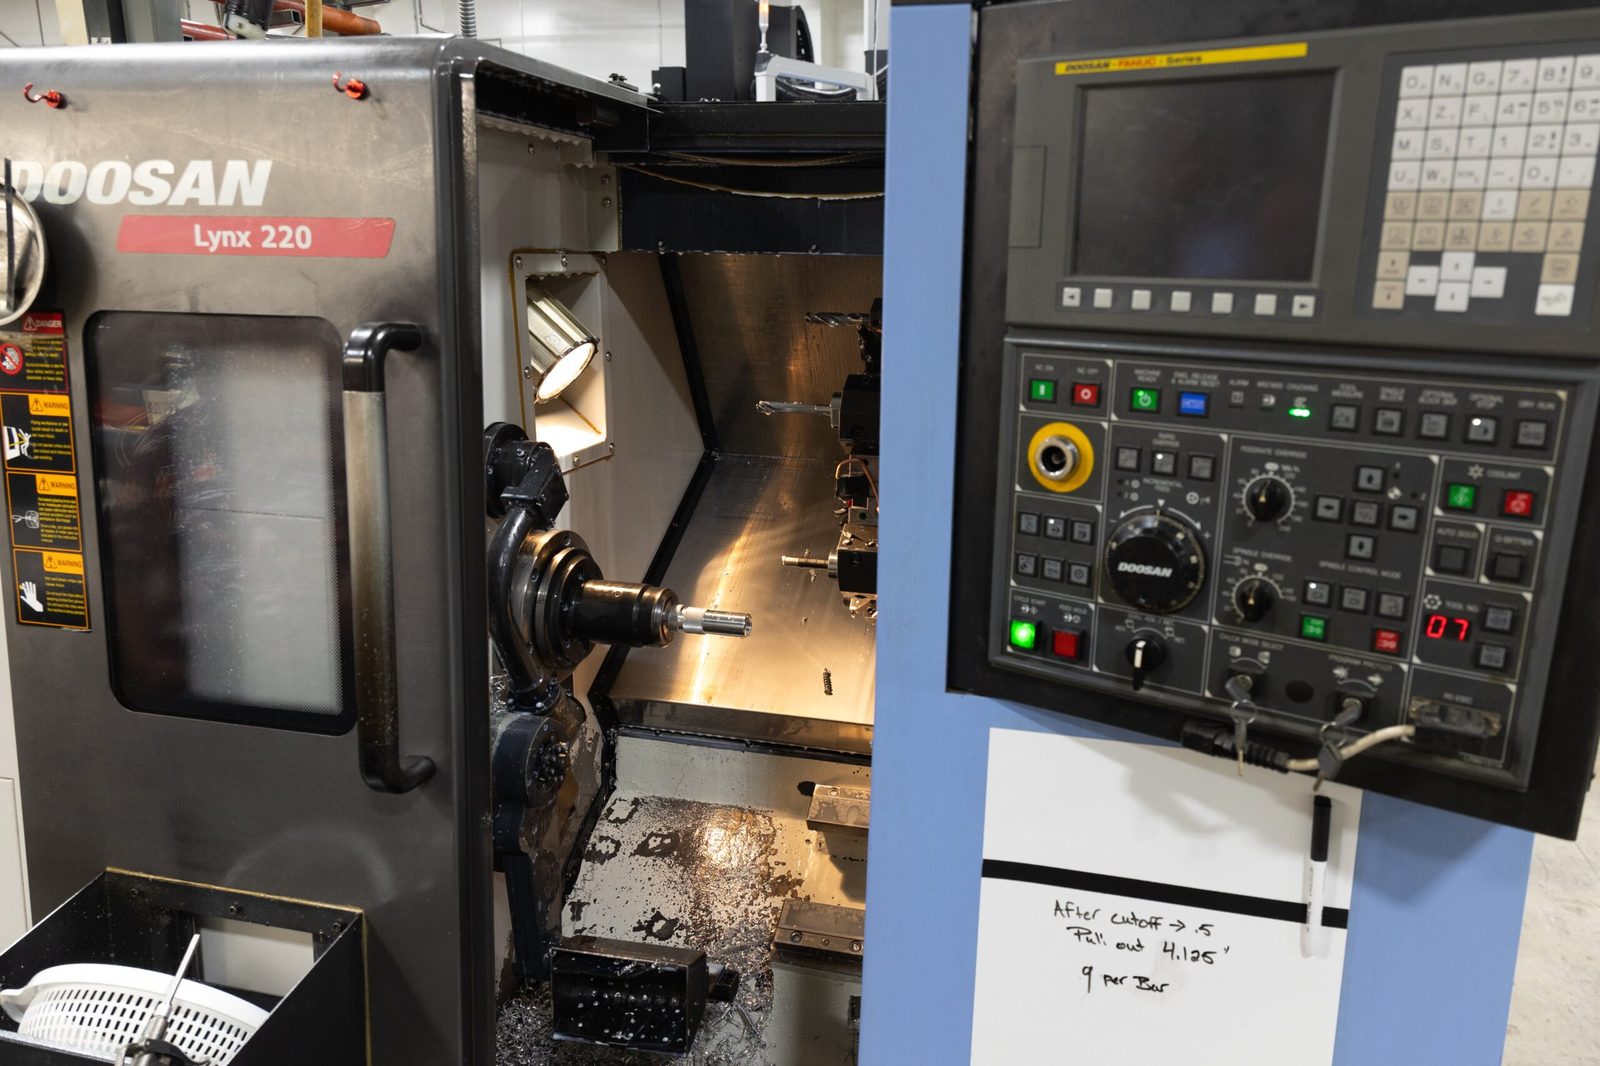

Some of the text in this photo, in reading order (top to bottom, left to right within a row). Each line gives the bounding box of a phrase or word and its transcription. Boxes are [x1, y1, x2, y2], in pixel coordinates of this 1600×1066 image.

[194, 224, 312, 253] Lynx 220
[36, 319, 62, 328] DANGER
[43, 401, 69, 410] WARNING
[50, 481, 76, 490] WARNING
[57, 560, 82, 569] WARNING
[1117, 561, 1173, 578] DOOSAN
[1426, 614, 1469, 641] 07
[1195, 923, 1214, 937] .5
[1116, 938, 1144, 952] out
[1082, 965, 1093, 993] 9
[1133, 976, 1169, 992] Bar
